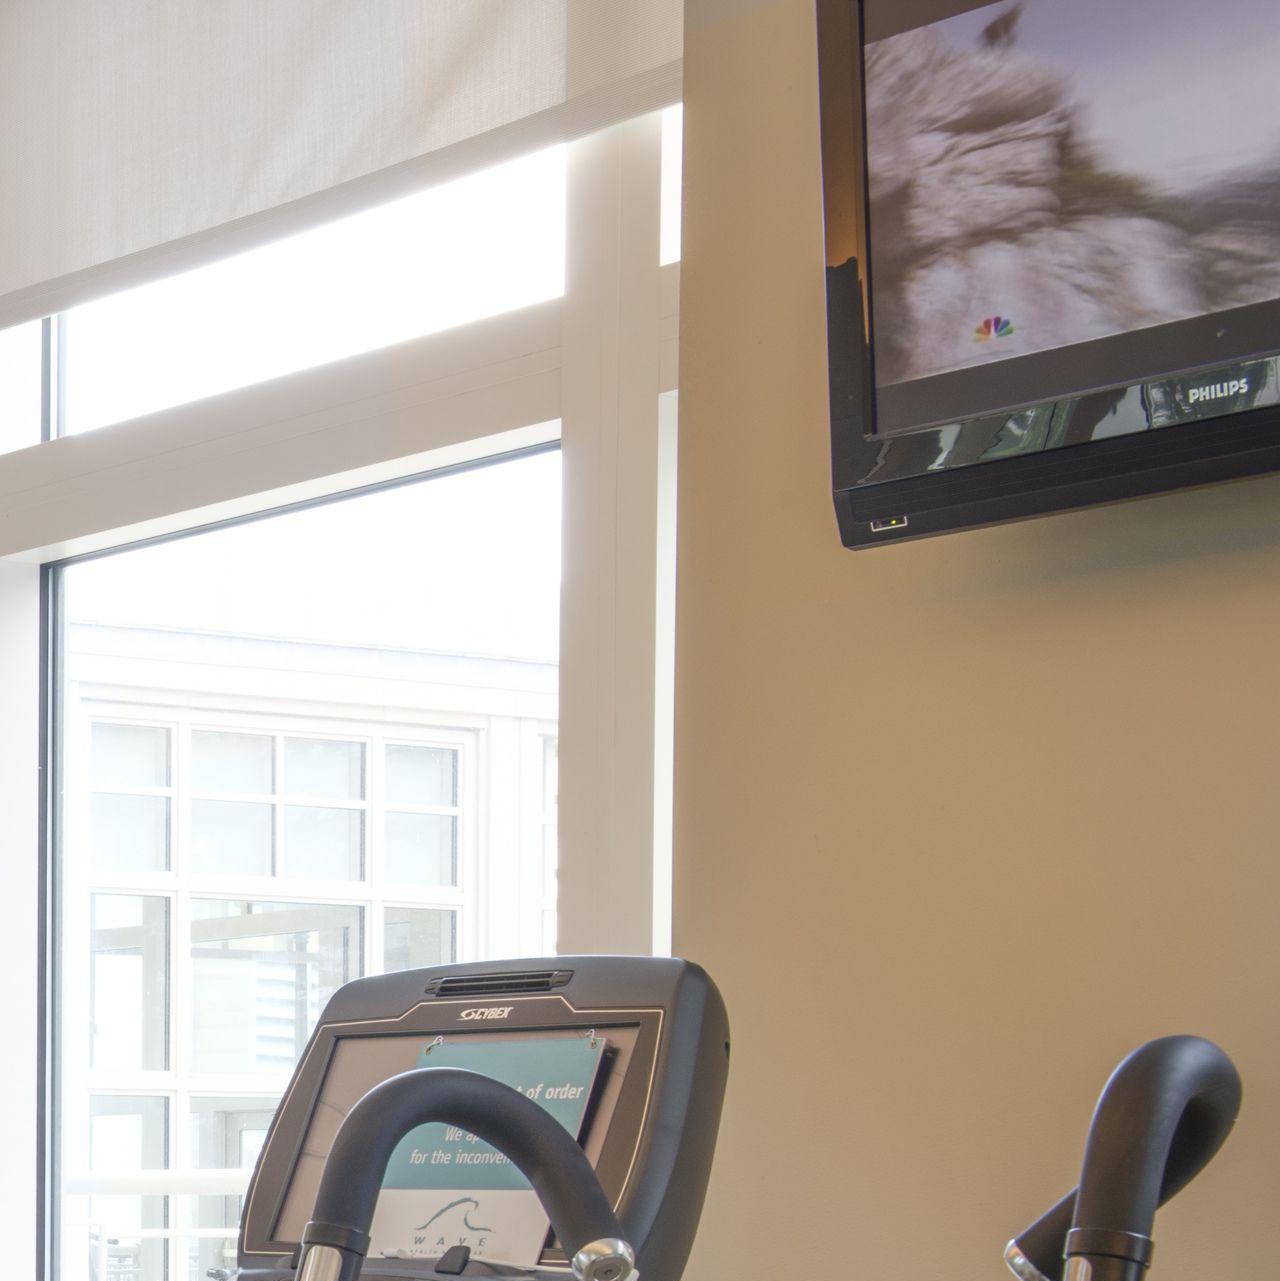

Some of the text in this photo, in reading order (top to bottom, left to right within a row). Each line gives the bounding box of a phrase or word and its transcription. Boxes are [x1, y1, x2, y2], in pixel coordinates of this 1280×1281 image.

[1188, 378, 1248, 404] PHILIPS
[473, 1006, 514, 1020] CYBEX
[526, 1083, 544, 1099] of
[545, 1083, 584, 1099] order
[445, 1127, 463, 1141] We
[409, 1149, 511, 1165] for the inconven
